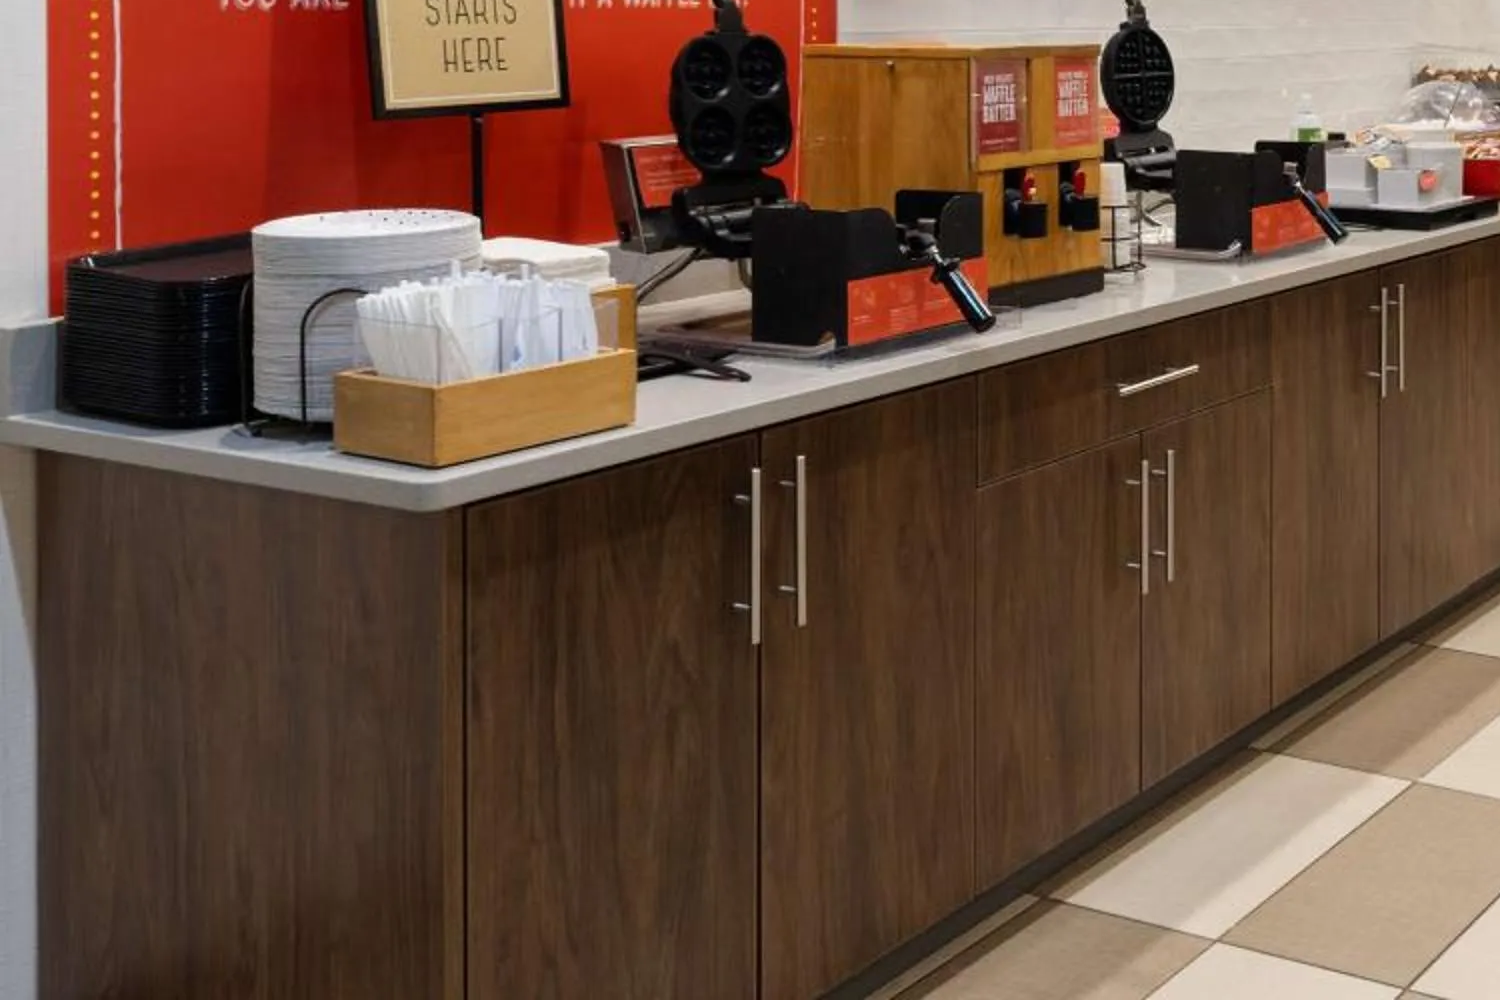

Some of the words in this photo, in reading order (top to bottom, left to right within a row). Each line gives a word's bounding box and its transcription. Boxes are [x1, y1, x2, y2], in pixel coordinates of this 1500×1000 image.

[443, 37, 509, 73] HERE
[983, 83, 1017, 104] WAFFLE
[1057, 79, 1089, 99] WAFFLE
